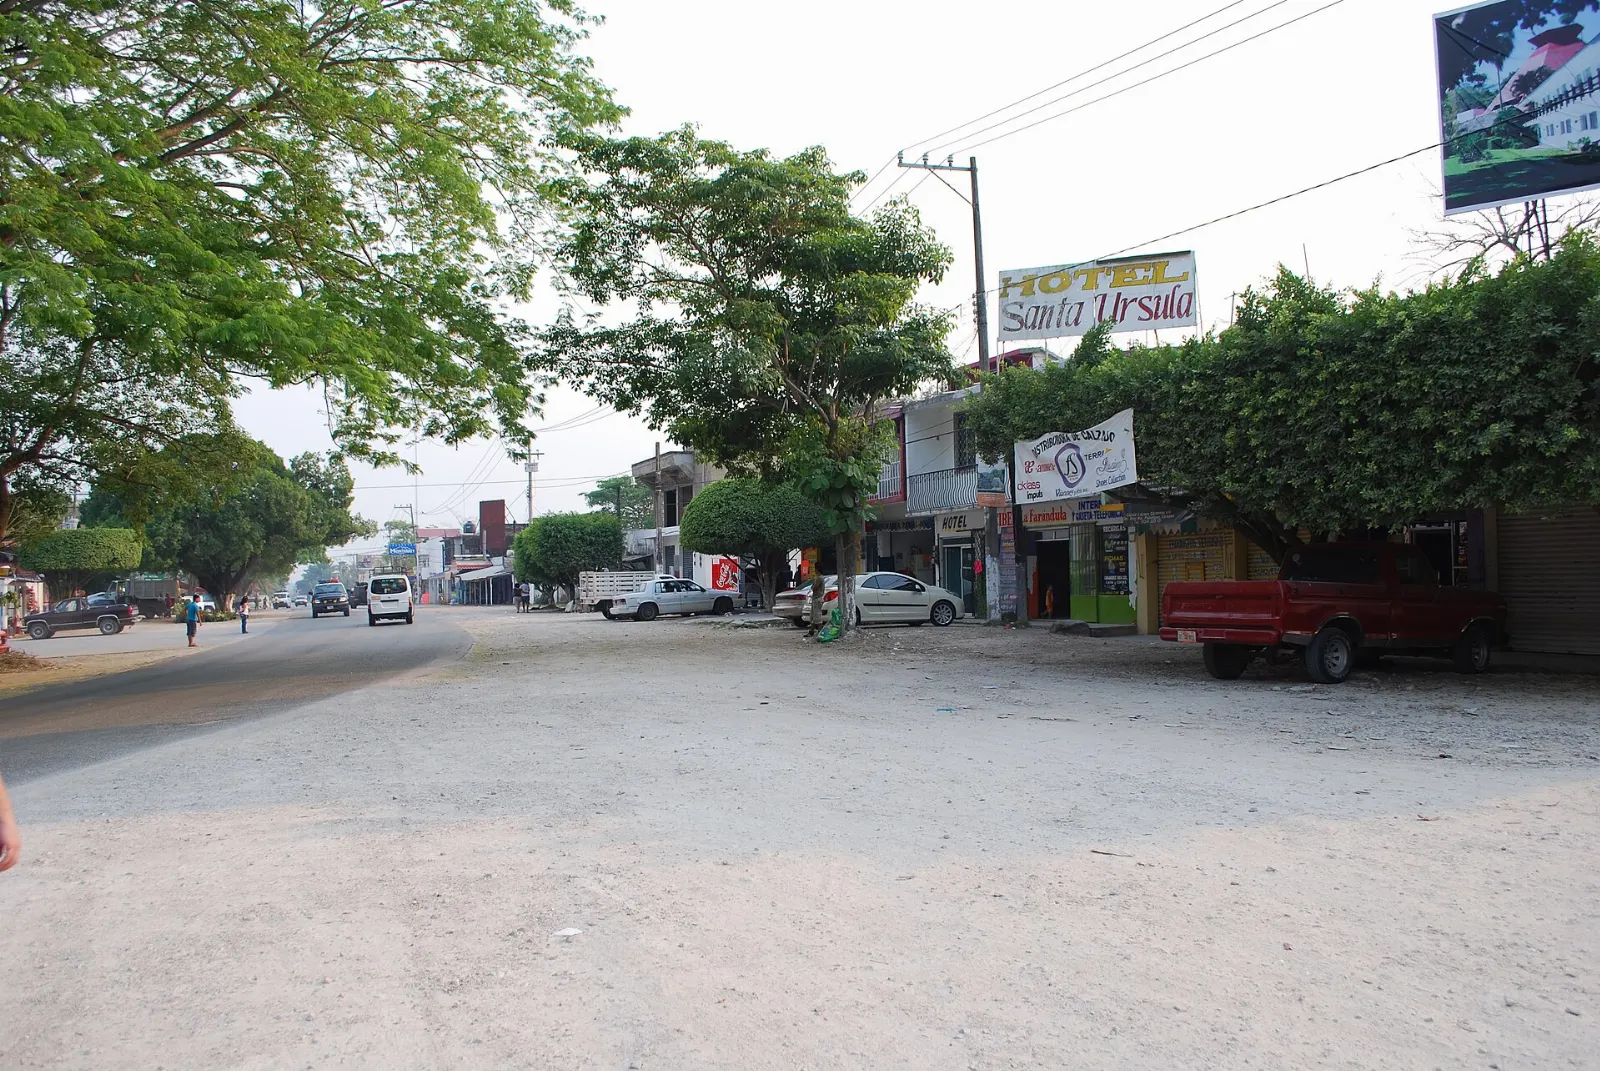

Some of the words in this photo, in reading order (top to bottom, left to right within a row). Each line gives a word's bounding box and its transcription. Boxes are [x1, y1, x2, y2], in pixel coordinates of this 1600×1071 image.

[999, 260, 1189, 298] HOTEL
[1003, 297, 1085, 333] Santa
[1095, 284, 1193, 324] Ursula
[1078, 500, 1102, 510] INTERN
[942, 515, 967, 529] HOTEL
